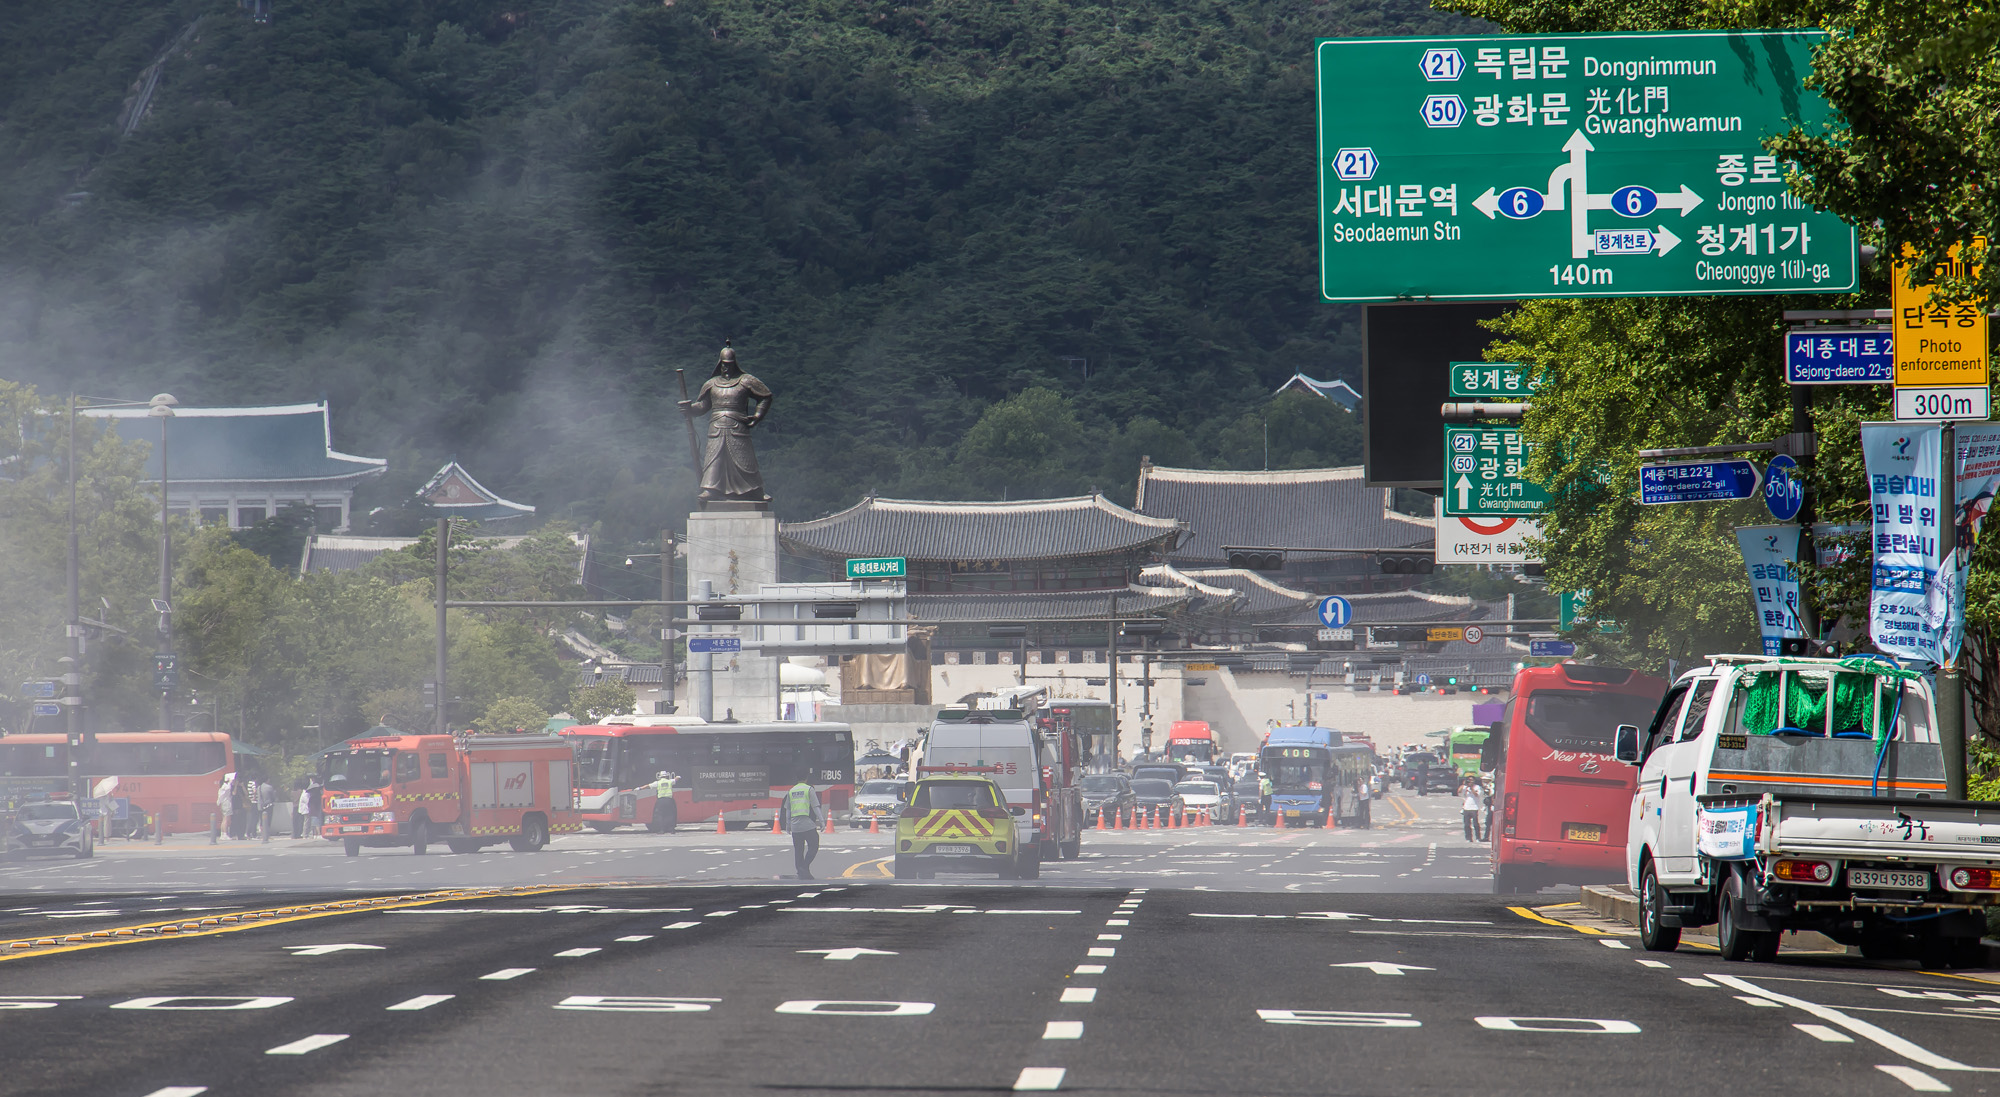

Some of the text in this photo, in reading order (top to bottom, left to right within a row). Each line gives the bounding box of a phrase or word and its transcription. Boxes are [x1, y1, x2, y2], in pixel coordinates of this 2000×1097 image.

[1431, 54, 1455, 77] 21
[1474, 46, 1570, 80] 독립문
[1583, 55, 1717, 80] Dongnimmun
[1473, 93, 1571, 127] 광화문
[1586, 86, 1670, 114] 光化門
[1431, 100, 1456, 123] 50
[1584, 113, 1742, 136] Gwanghwamun
[1344, 153, 1368, 175] 21
[1333, 183, 1458, 218] 서대문역
[1512, 190, 1529, 214] 6
[1626, 190, 1642, 213] 6
[1717, 191, 1776, 216] Jongno
[1334, 221, 1461, 243] Seodaemun Stn
[1598, 232, 1648, 251] 청계천로
[1696, 222, 1812, 257] 청계1가
[1549, 264, 1613, 286] 140m
[1695, 260, 1830, 285] Cheonggye 1(il)-ga
[1903, 304, 1978, 329] 단속중
[1795, 338, 1893, 359] 세종대로2
[1920, 339, 1962, 353] Photo
[1795, 364, 1866, 380] Sejong-daero
[1900, 358, 1982, 371] enforcement
[1915, 394, 1972, 415] 300m
[1456, 437, 1472, 449] 21
[1457, 458, 1472, 469] 50
[1644, 466, 1714, 482] 세종대로22길
[1480, 483, 1523, 497] 光化門
[1644, 479, 1726, 493] Sejong-daero 22-gil
[1873, 474, 1936, 497] 공습대비
[1479, 498, 1544, 511] Gwanghwamun
[1454, 543, 1492, 556] (자전거
[1876, 533, 1935, 557] 훈련실시
[852, 561, 899, 574] 세종대로사거리
[1879, 604, 1898, 614] 오후
[1467, 631, 1480, 639] 50
[1884, 619, 1920, 632] 경보해제
[1282, 748, 1310, 758] 406
[1543, 750, 1577, 762] New
[1891, 872, 1924, 887] 9388
[552, 995, 936, 1016] 50
[1257, 1008, 1641, 1033] 50
